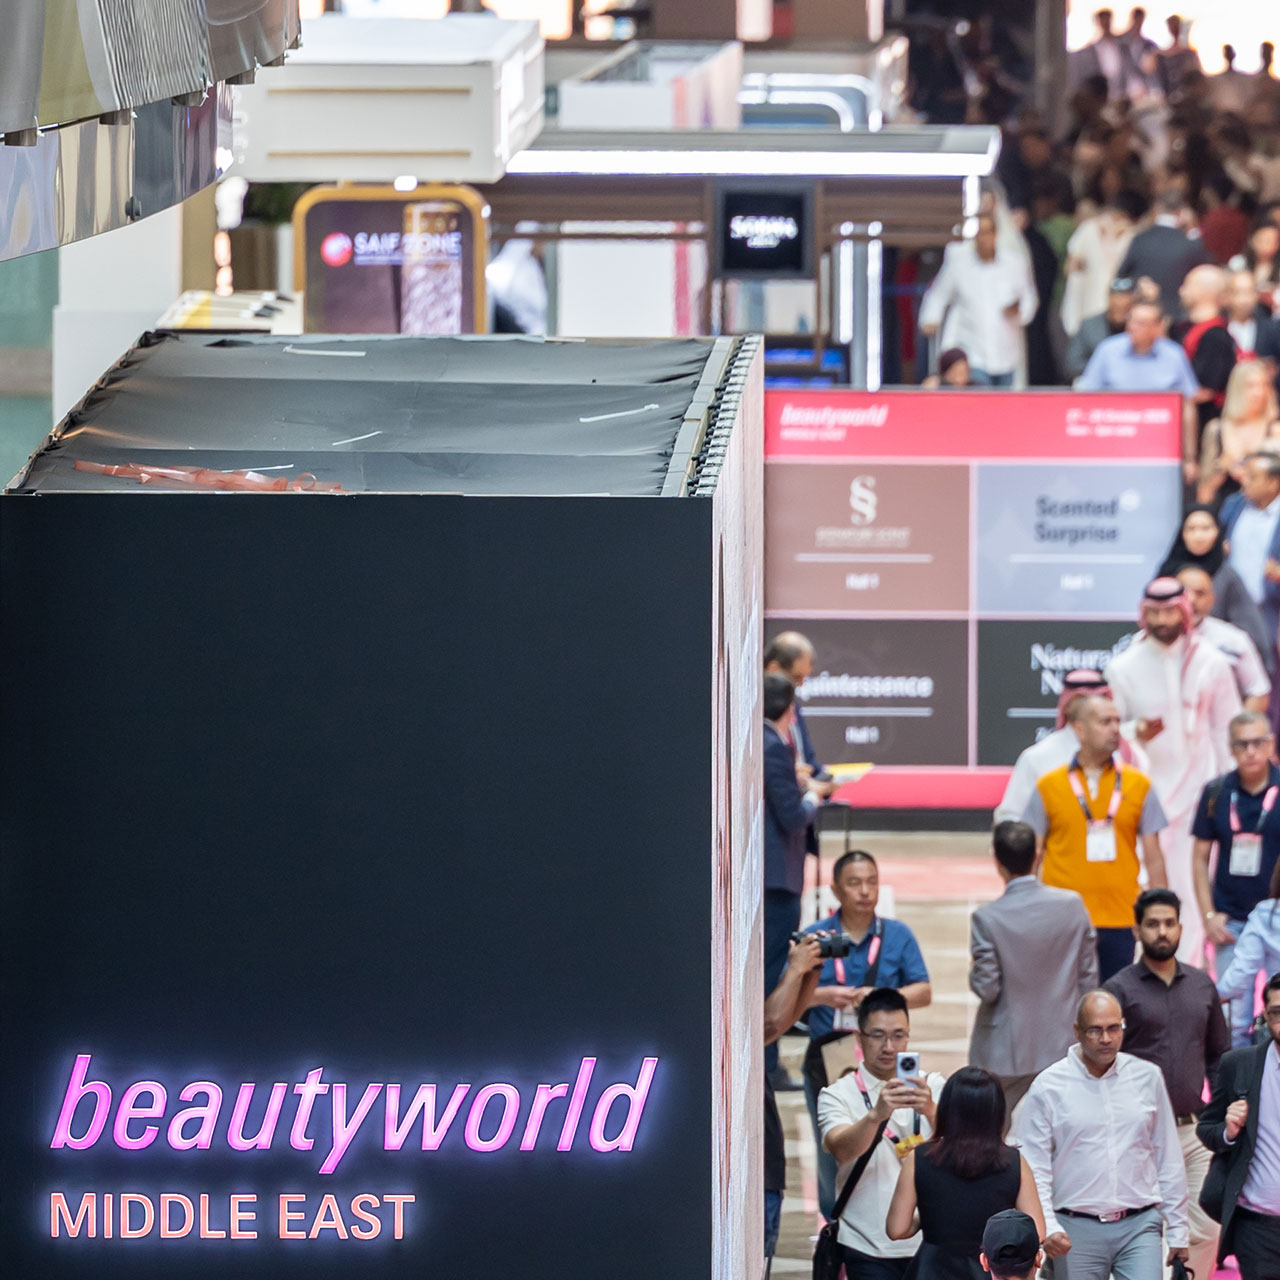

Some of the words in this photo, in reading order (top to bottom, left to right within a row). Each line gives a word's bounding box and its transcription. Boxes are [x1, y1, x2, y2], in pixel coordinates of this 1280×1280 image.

[1036, 494, 1119, 518] Scented
[1034, 521, 1119, 547] Surprise
[795, 670, 933, 701] uintessence
[50, 1054, 658, 1174] beautyworld
[50, 1192, 259, 1239] MIDDLE
[278, 1193, 417, 1240] EAST
